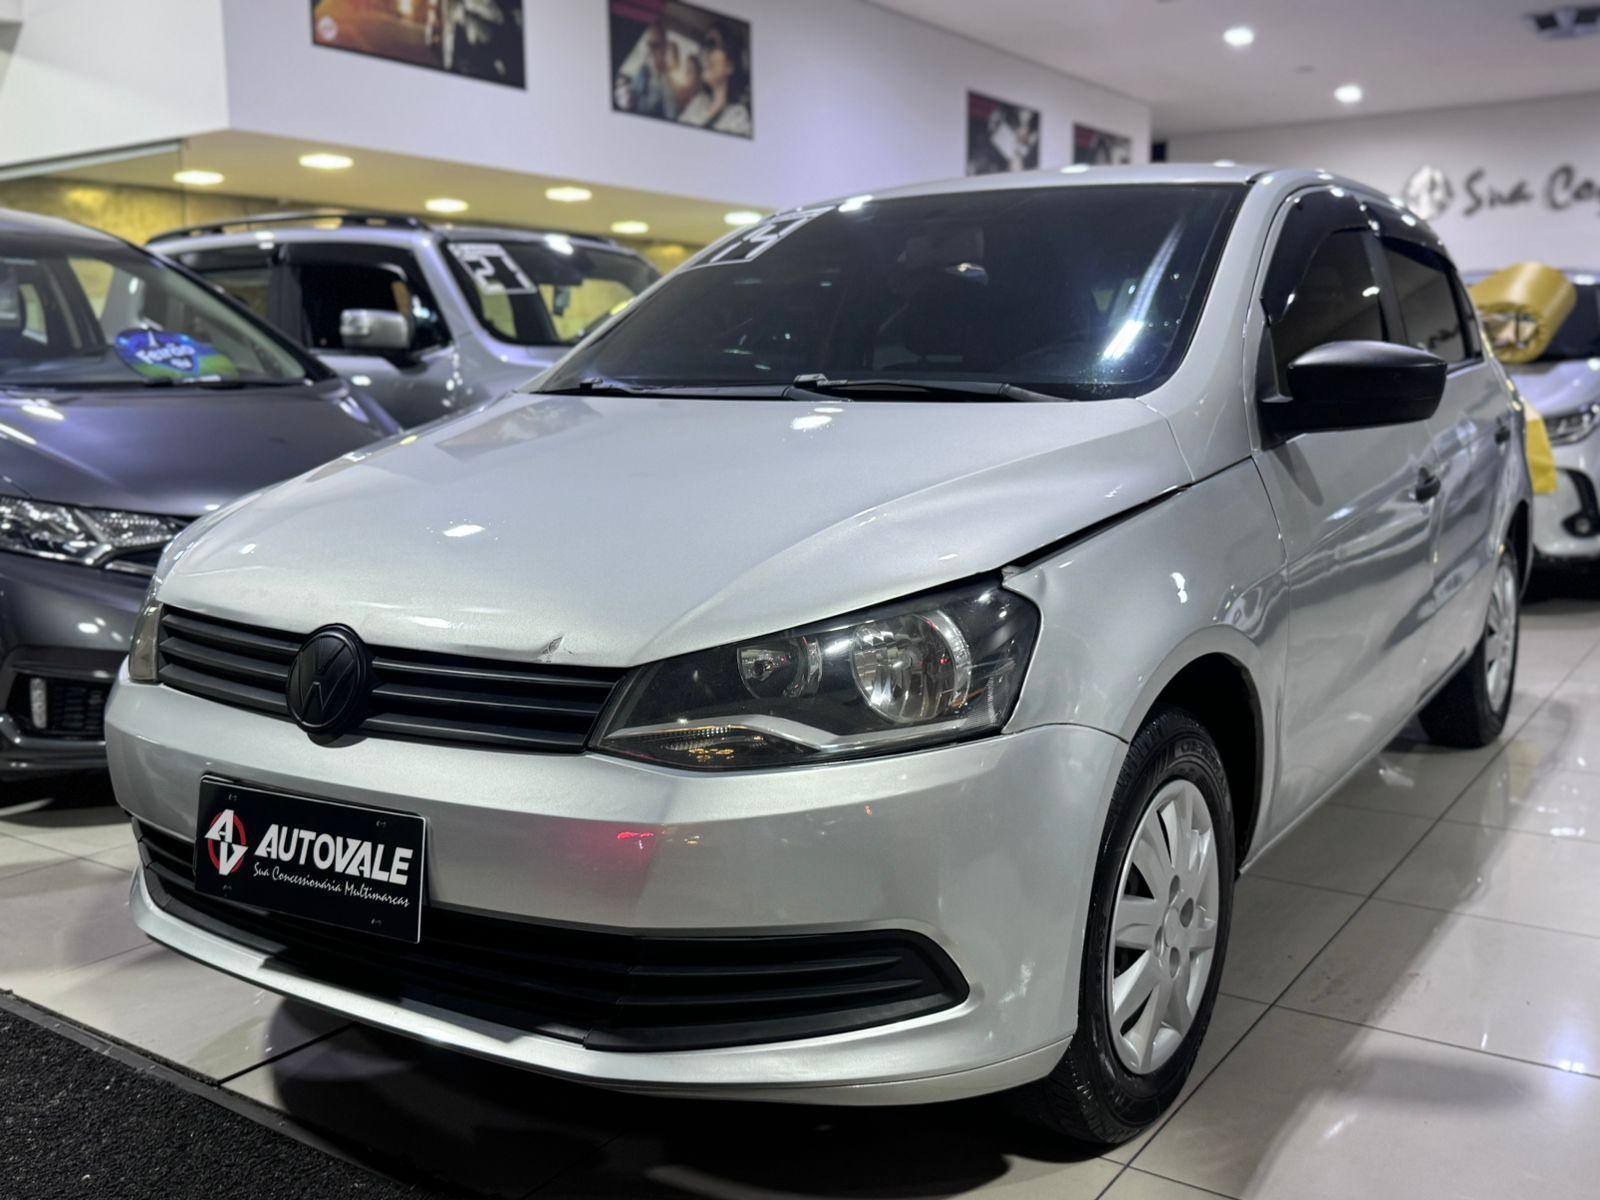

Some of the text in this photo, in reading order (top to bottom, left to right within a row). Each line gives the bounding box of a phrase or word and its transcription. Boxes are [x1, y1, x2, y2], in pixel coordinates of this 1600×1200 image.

[1545, 162, 1600, 217] Co
[254, 824, 413, 886] AUTOVALE
[253, 861, 411, 908] Sua Concessionária Multimarcas
